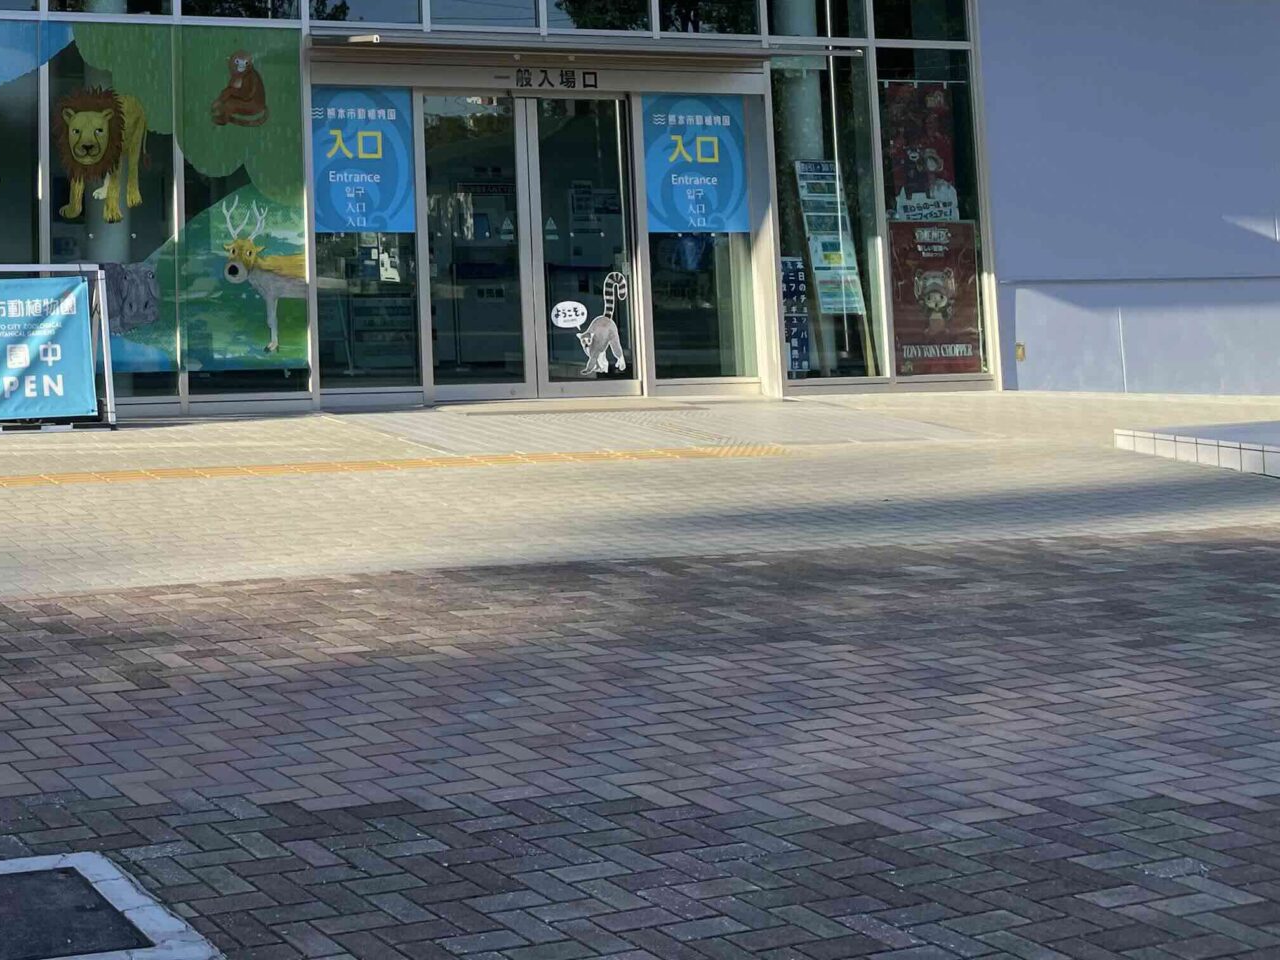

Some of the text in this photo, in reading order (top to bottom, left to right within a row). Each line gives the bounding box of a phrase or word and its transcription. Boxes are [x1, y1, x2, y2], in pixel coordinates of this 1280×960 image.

[494, 68, 598, 89] 一般入場口
[326, 129, 383, 159] 入口
[669, 135, 719, 163] 入口
[329, 170, 381, 182] Entrance
[671, 174, 718, 185] Entrance
[346, 202, 366, 213] 入口
[687, 204, 705, 214] 入口
[346, 216, 367, 227] 入口
[688, 217, 706, 227] 入口
[902, 345, 921, 358] TONY
[941, 344, 974, 357] CHOPPER
